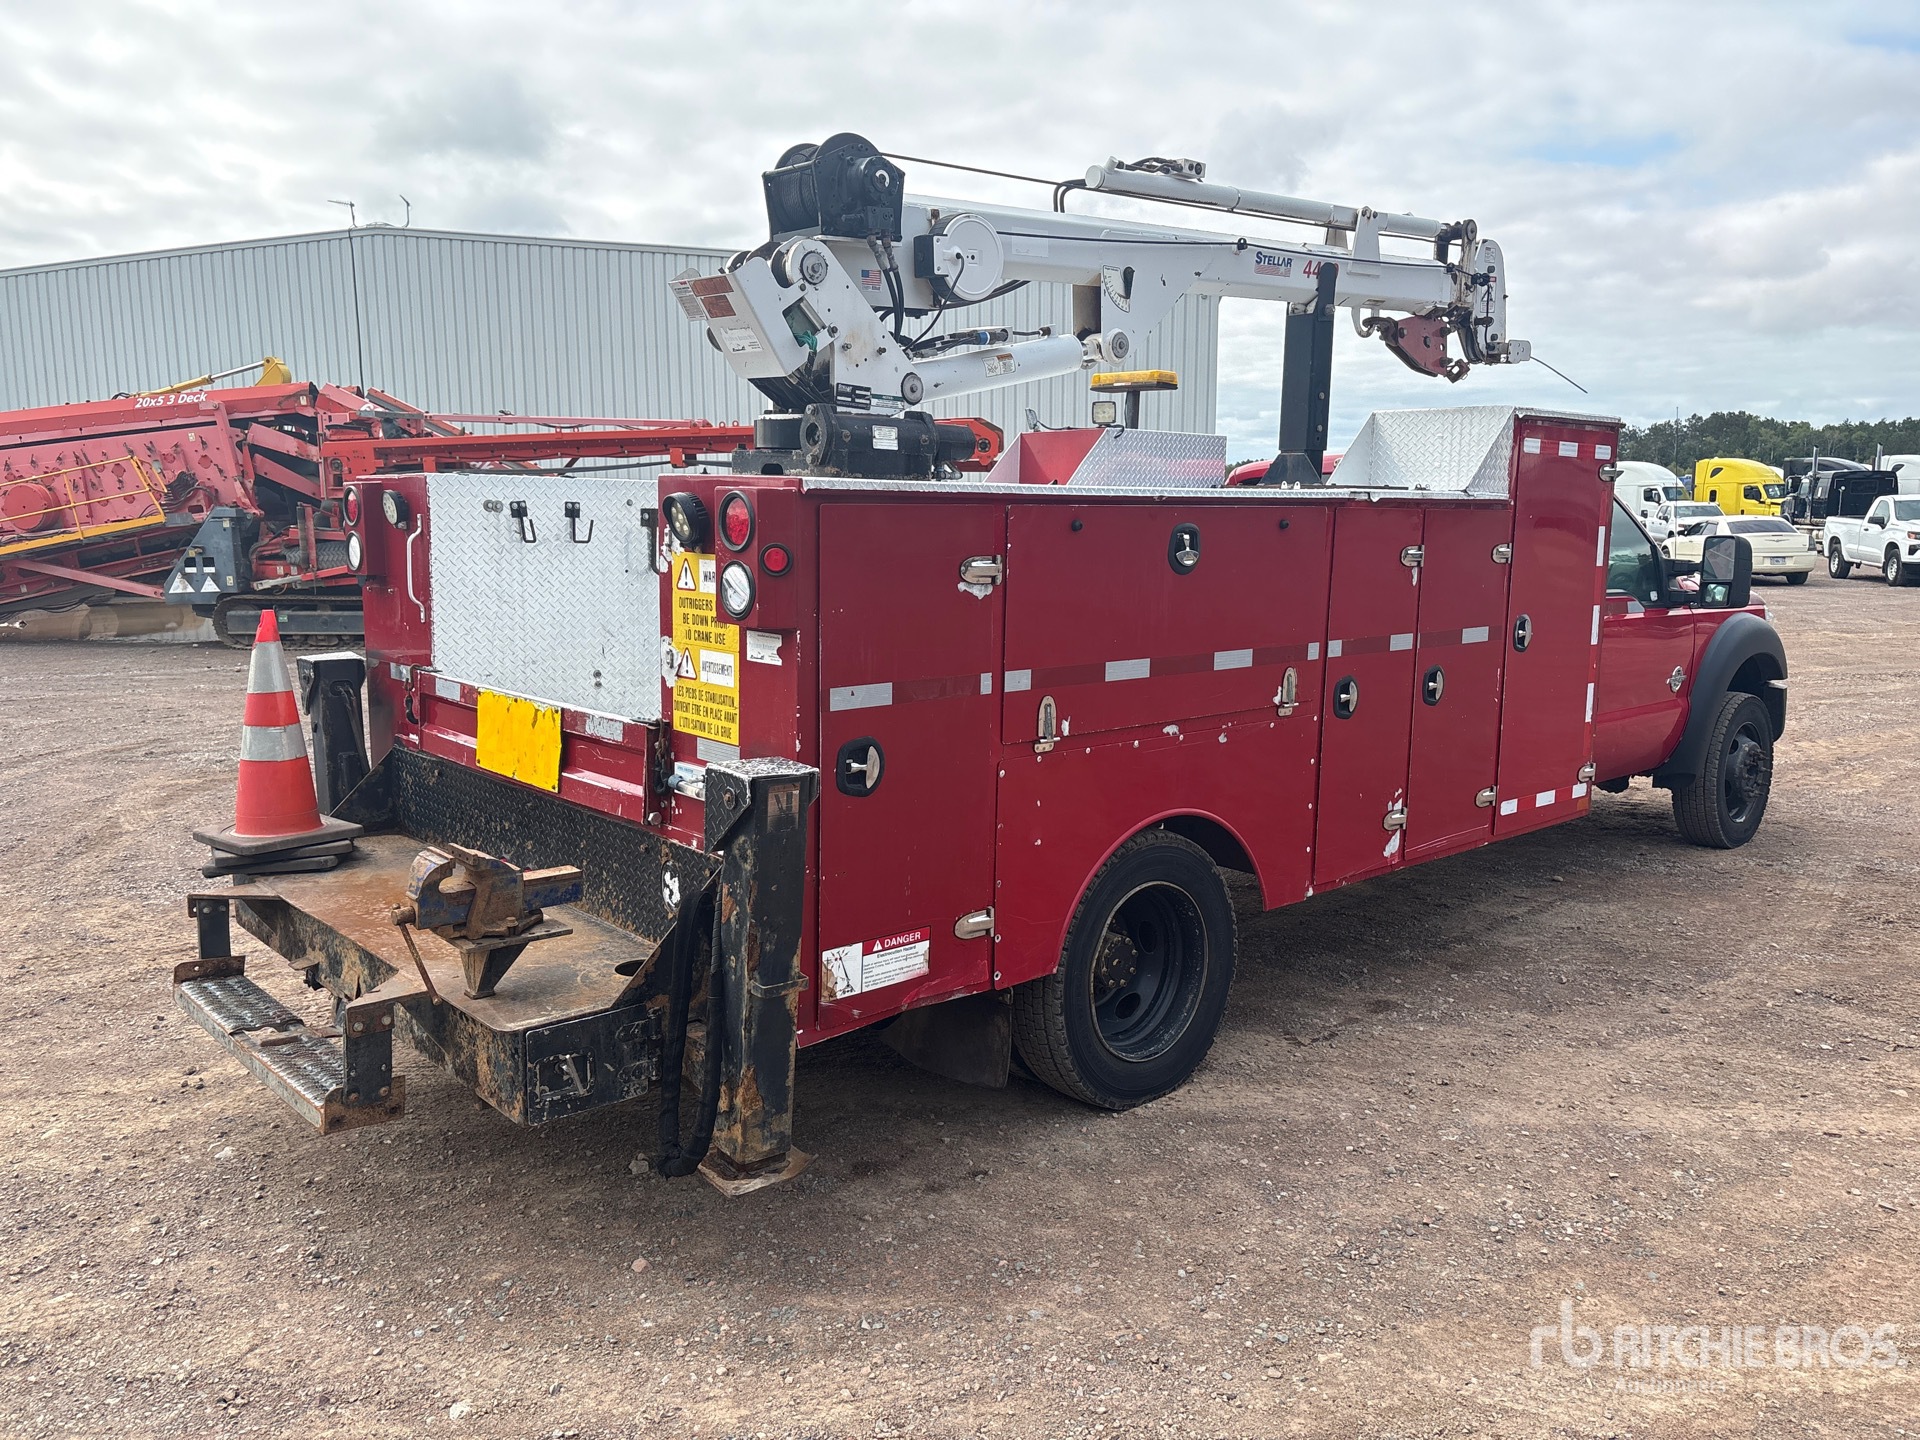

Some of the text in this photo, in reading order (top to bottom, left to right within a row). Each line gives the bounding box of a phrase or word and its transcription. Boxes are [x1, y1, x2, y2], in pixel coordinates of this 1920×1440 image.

[1255, 251, 1293, 268] STELLAR
[134, 392, 208, 408] 20x5 3 Deck
[679, 597, 713, 611] OUTRIGGERS
[682, 613, 690, 624] BE
[691, 614, 709, 627] DOWN
[693, 630, 712, 643] CRANE
[714, 633, 726, 645] USE
[676, 685, 735, 708] LES PIEDS DE STABILISATION
[703, 705, 709, 718] EN
[710, 708, 723, 721] PLACE
[707, 722, 713, 735] DE
[714, 724, 720, 736] LA
[884, 931, 921, 947] DANGER
